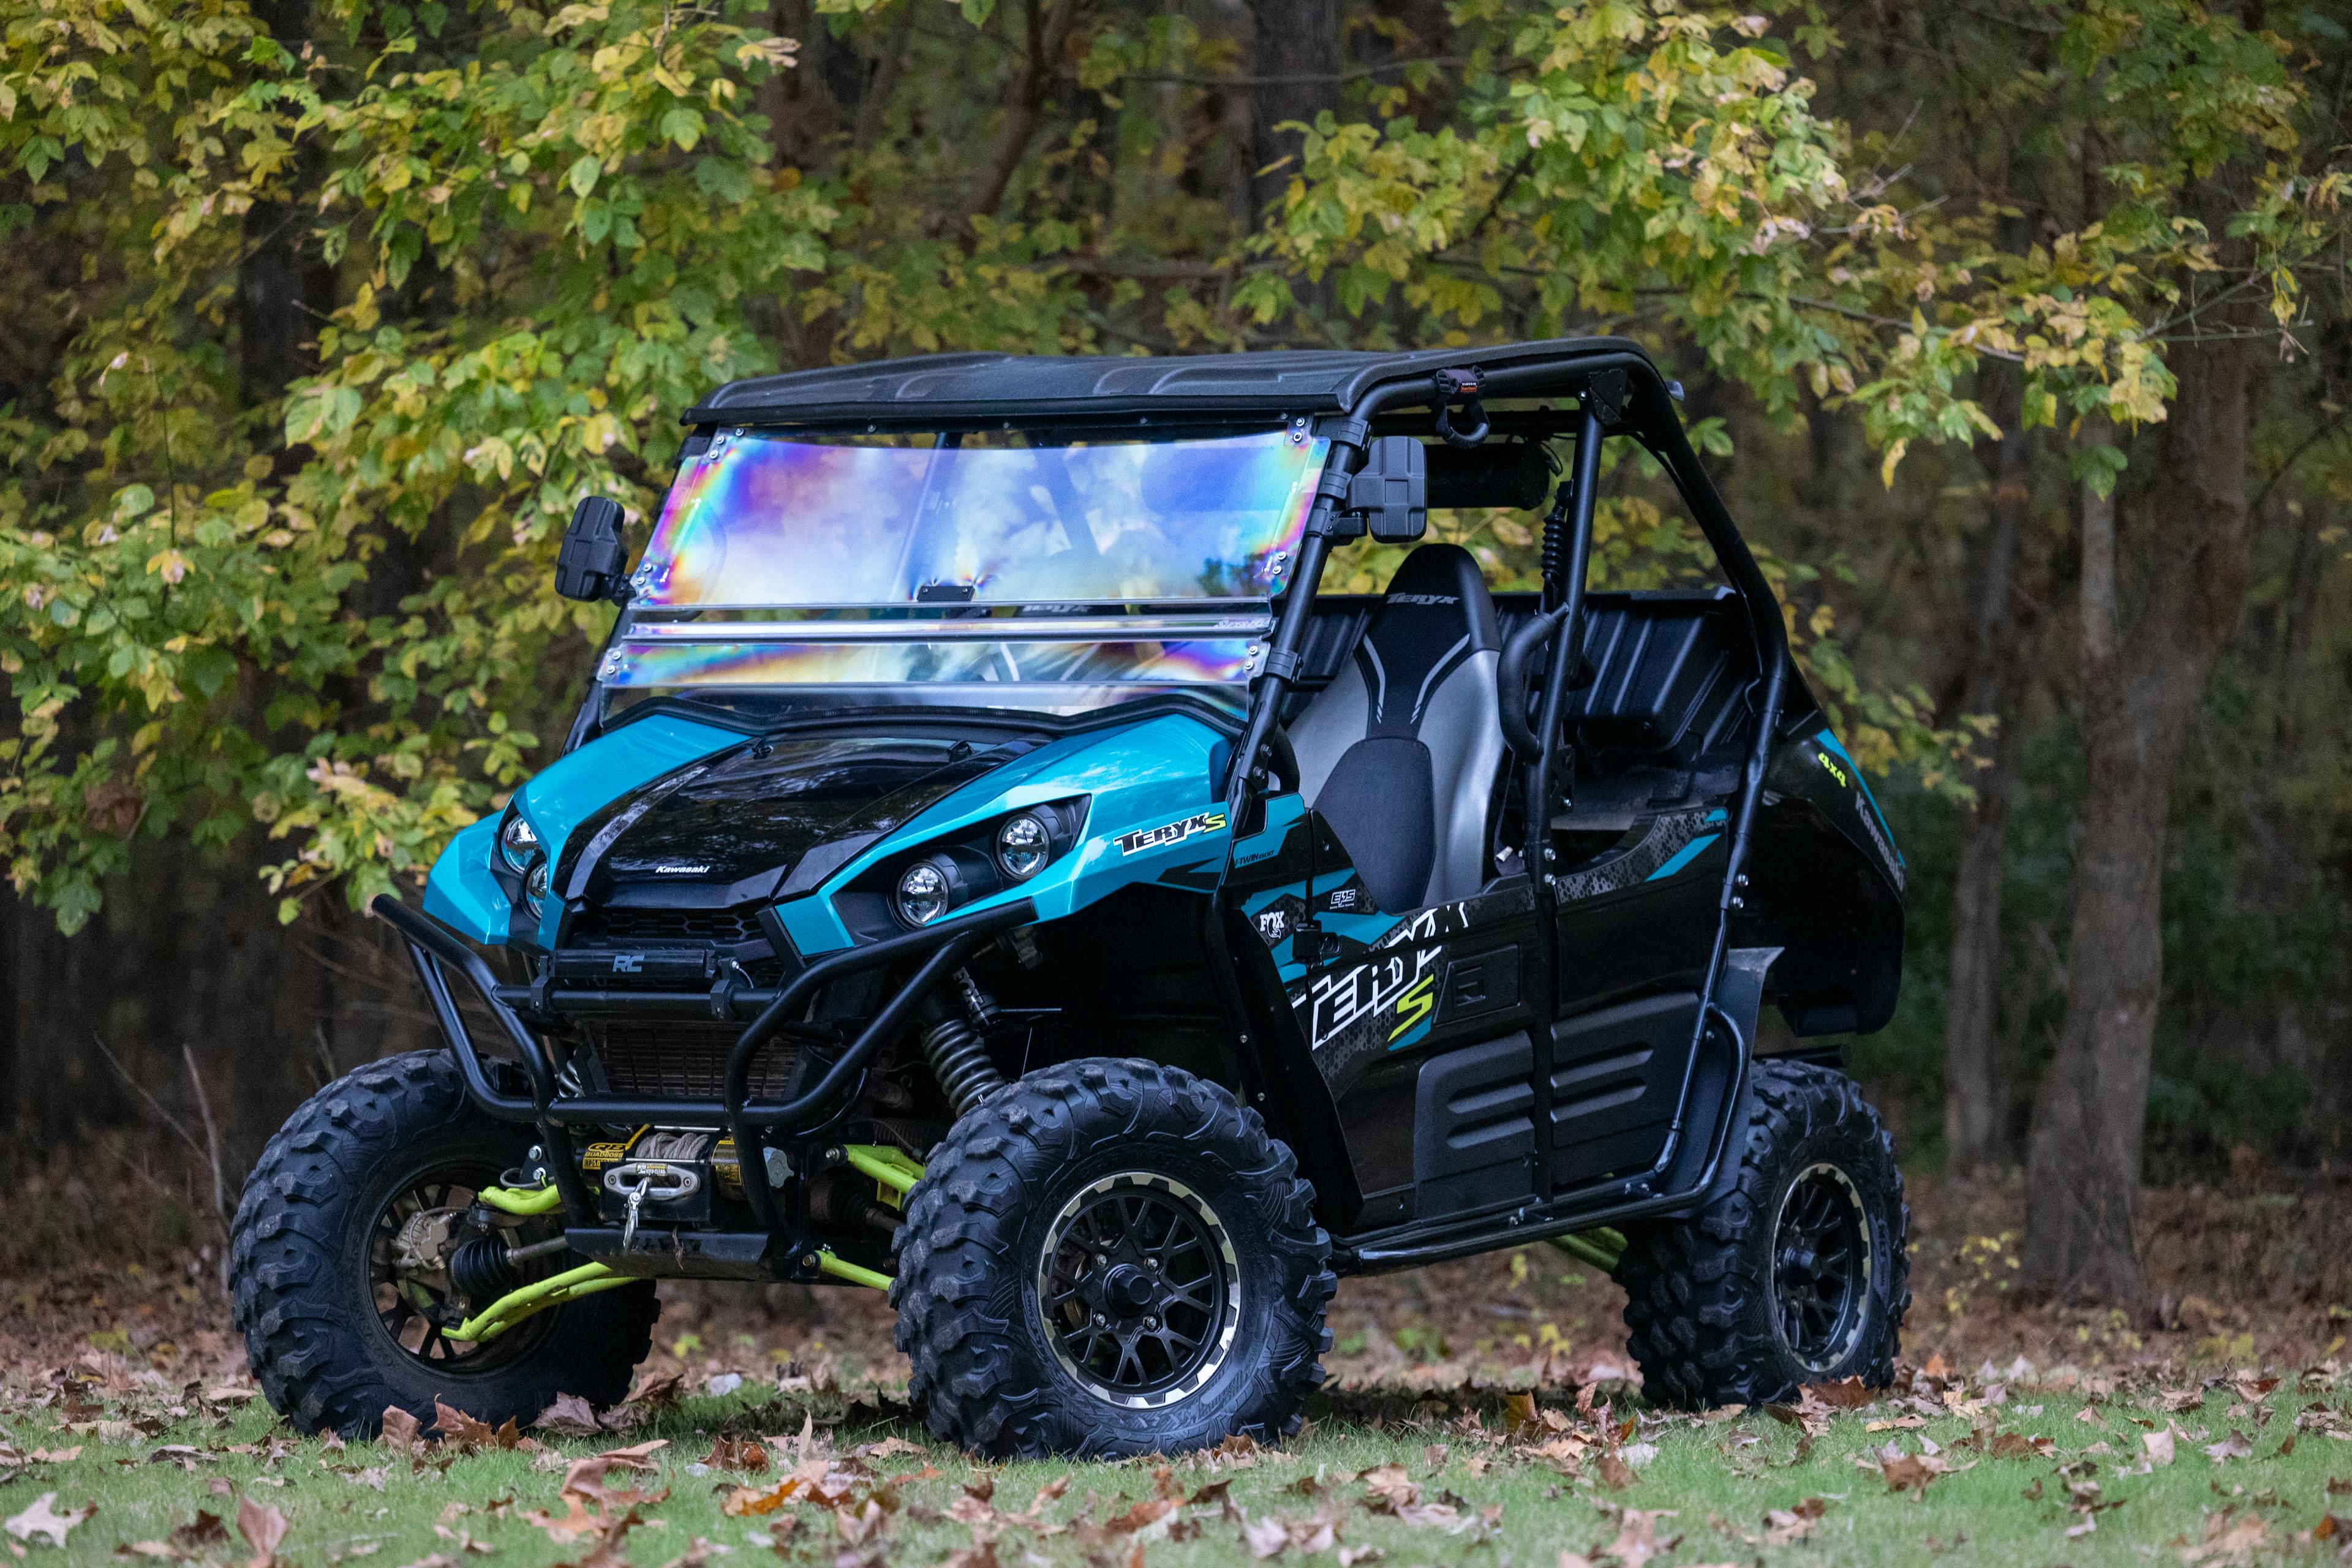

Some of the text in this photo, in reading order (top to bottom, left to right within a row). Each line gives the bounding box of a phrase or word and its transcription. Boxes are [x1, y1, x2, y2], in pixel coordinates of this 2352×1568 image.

[1817, 752, 1847, 788] 4x4
[655, 865, 710, 873] Kawasaki
[1259, 911, 1285, 940] FOX
[612, 956, 645, 973] RC
